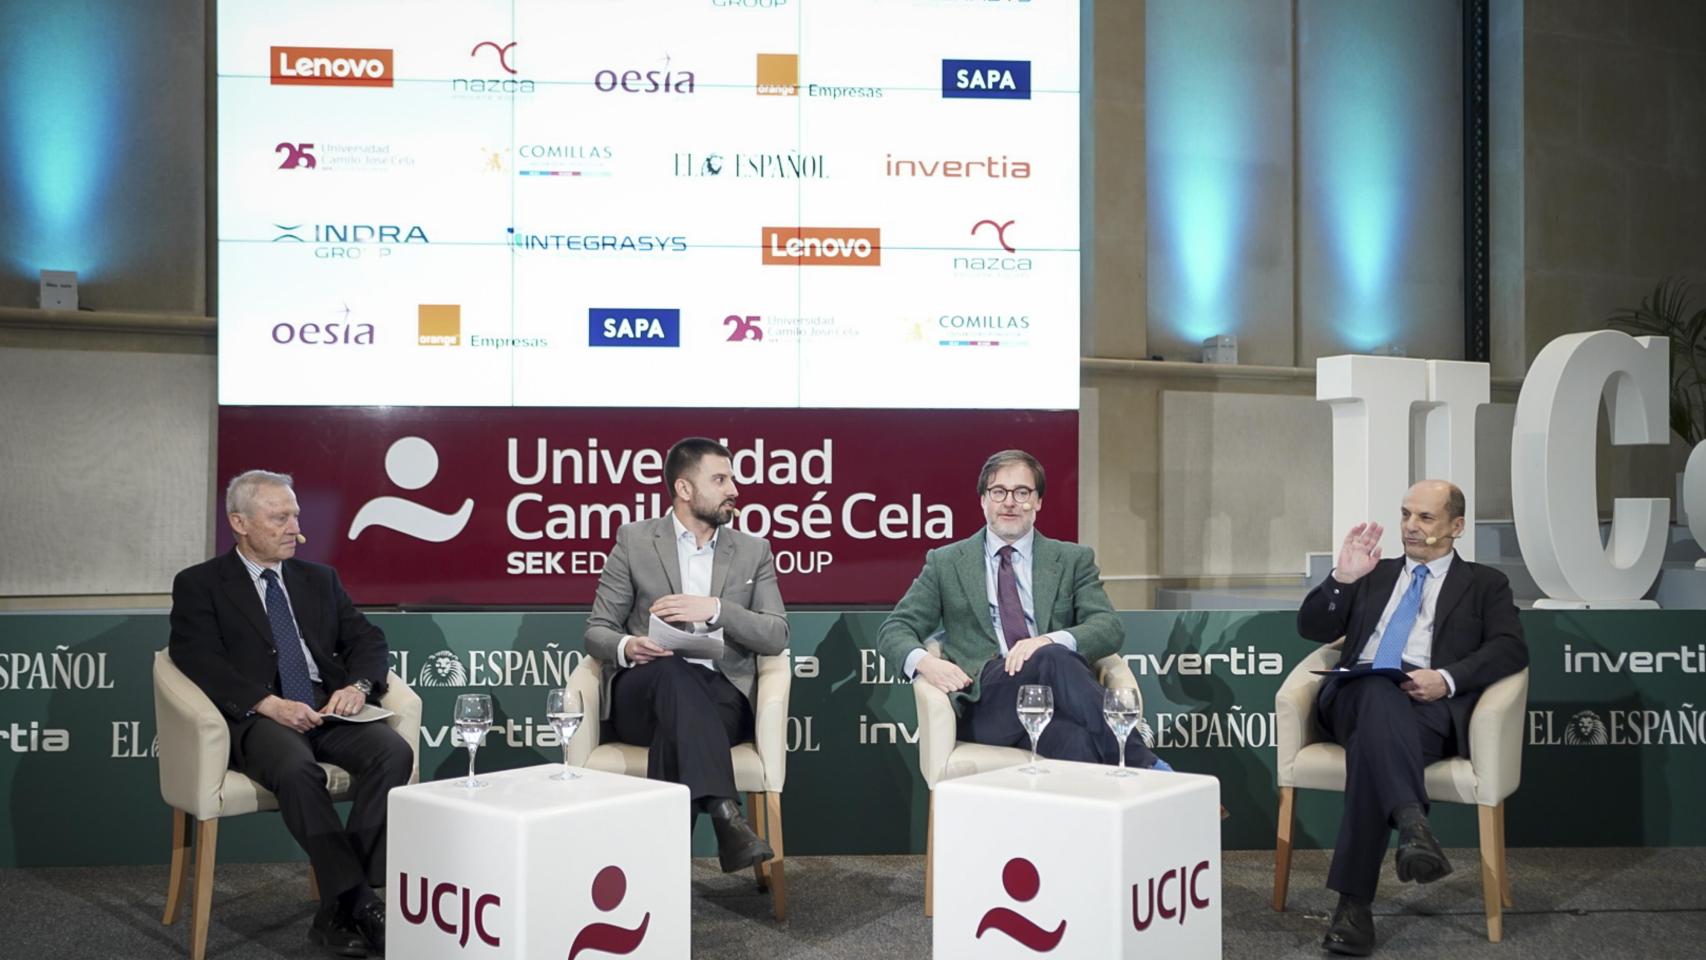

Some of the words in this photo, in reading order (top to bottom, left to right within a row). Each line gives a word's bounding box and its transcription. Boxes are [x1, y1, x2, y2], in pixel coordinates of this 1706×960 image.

[280, 53, 385, 79] Lenovo
[453, 78, 535, 94] nazca
[757, 84, 795, 96] orange
[809, 84, 883, 100] Empresas
[956, 69, 1017, 90] SAPA
[275, 142, 317, 170] 25
[519, 145, 612, 160] COMILLAS
[886, 154, 1031, 178] invertia
[315, 224, 430, 244] INDRA
[525, 235, 687, 252] INTEGRASYS
[770, 234, 872, 259] Lenovo
[315, 247, 391, 259] GROP
[953, 257, 1032, 271] nazca
[603, 318, 665, 339] SAPA
[723, 315, 763, 342] 25
[938, 316, 1030, 330] COMILLAS
[419, 335, 457, 346] orange
[470, 335, 549, 349] Empresas
[507, 438, 833, 485] Univedad
[506, 492, 675, 540] Camil
[724, 491, 833, 540] osé
[841, 491, 954, 540] Cela
[506, 551, 566, 574] SEK
[775, 550, 833, 574] OUP
[0, 645, 114, 689] SPAÑOL
[469, 642, 584, 687] ESPAÑO
[860, 649, 894, 684] EL
[1122, 645, 1283, 675] nvertia
[1564, 644, 1706, 673] inverti
[420, 717, 562, 748] vertia
[1528, 711, 1561, 745] EL
[1609, 703, 1706, 745] ESPAÑ
[111, 721, 148, 758] EL
[1132, 860, 1210, 932] UCJC
[400, 872, 501, 949] UCJC
